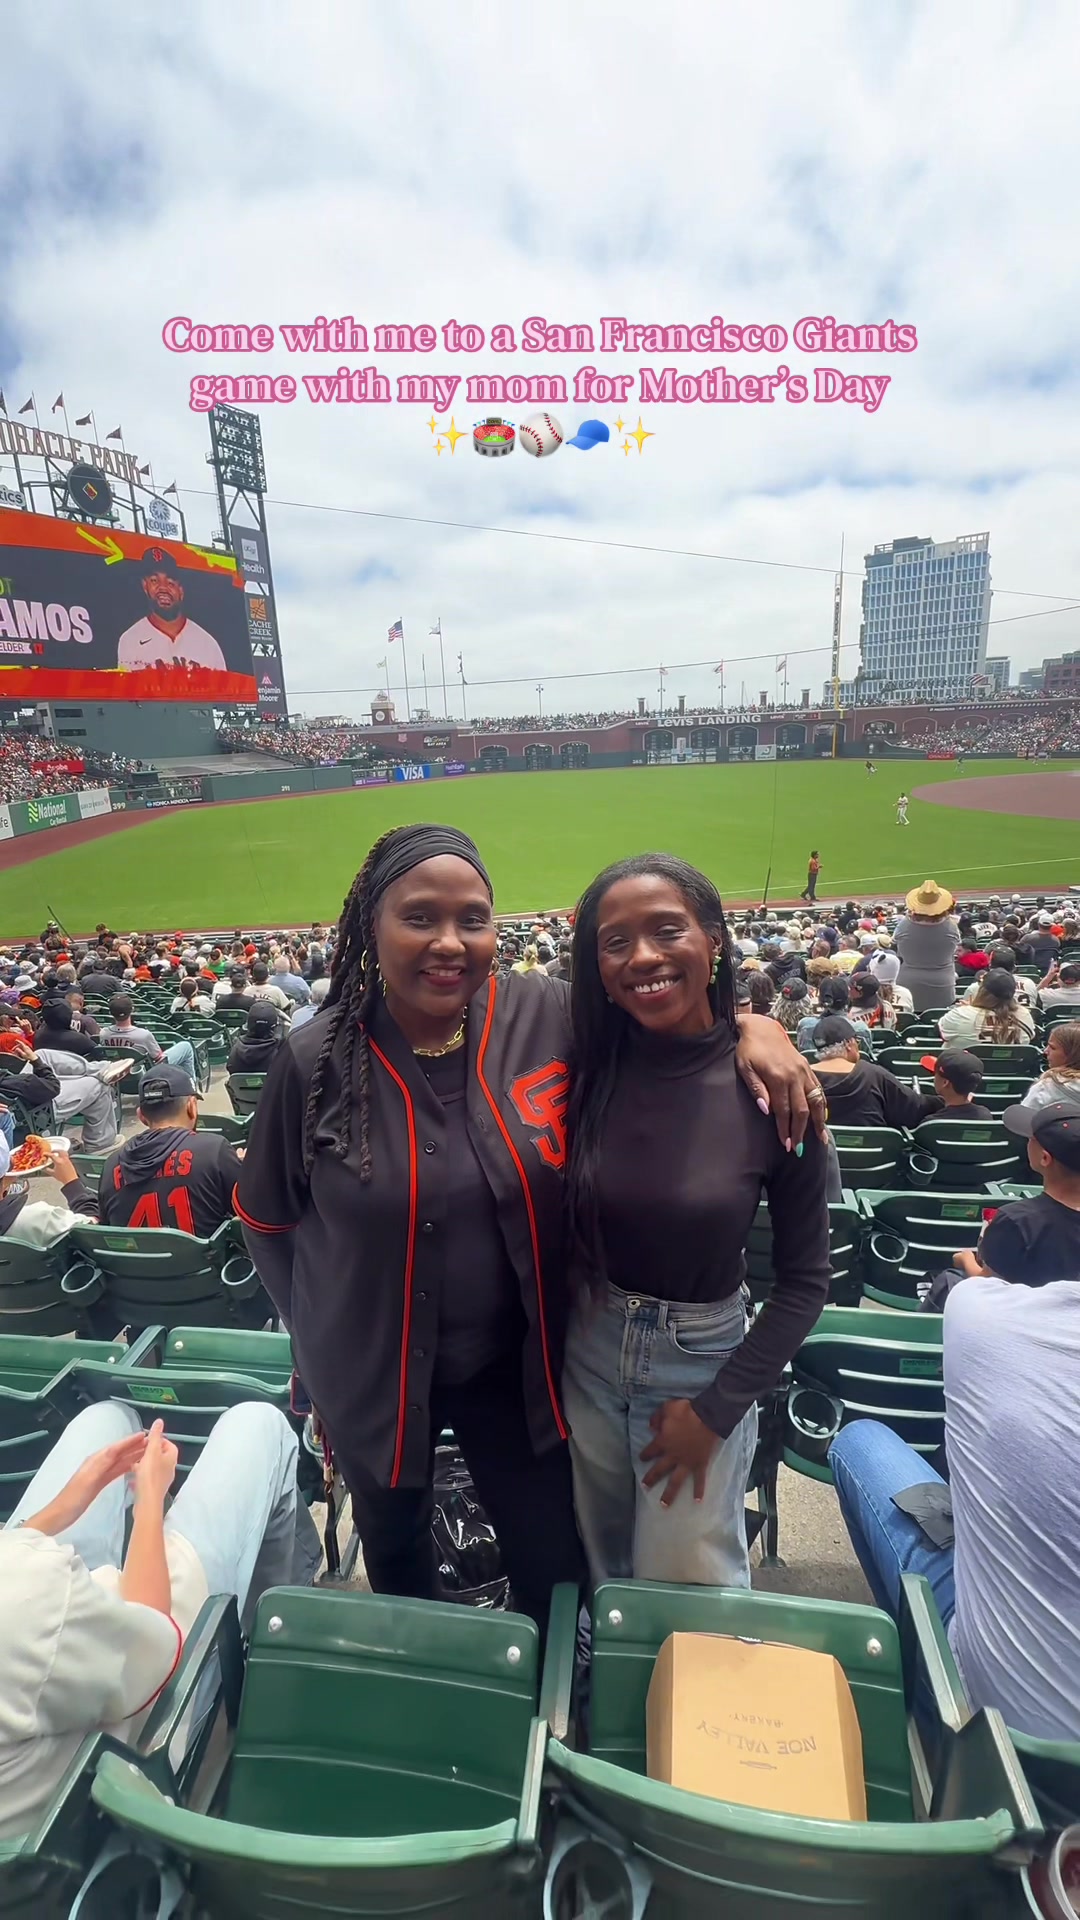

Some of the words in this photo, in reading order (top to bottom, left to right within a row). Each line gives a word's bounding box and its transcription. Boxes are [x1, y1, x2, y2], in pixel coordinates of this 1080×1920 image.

[88, 443, 143, 486] PARK
[149, 519, 177, 535] coupa
[241, 561, 265, 574] Health
[249, 628, 272, 637] CREEK
[258, 686, 281, 695] enjamin
[698, 714, 761, 726] LANDING
[401, 766, 424, 780] VISA
[38, 800, 67, 820] National
[112, 802, 126, 810] 399
[127, 1185, 196, 1235] 41
[696, 1720, 770, 1754] VALLEY
[776, 1736, 817, 1755] NOE
